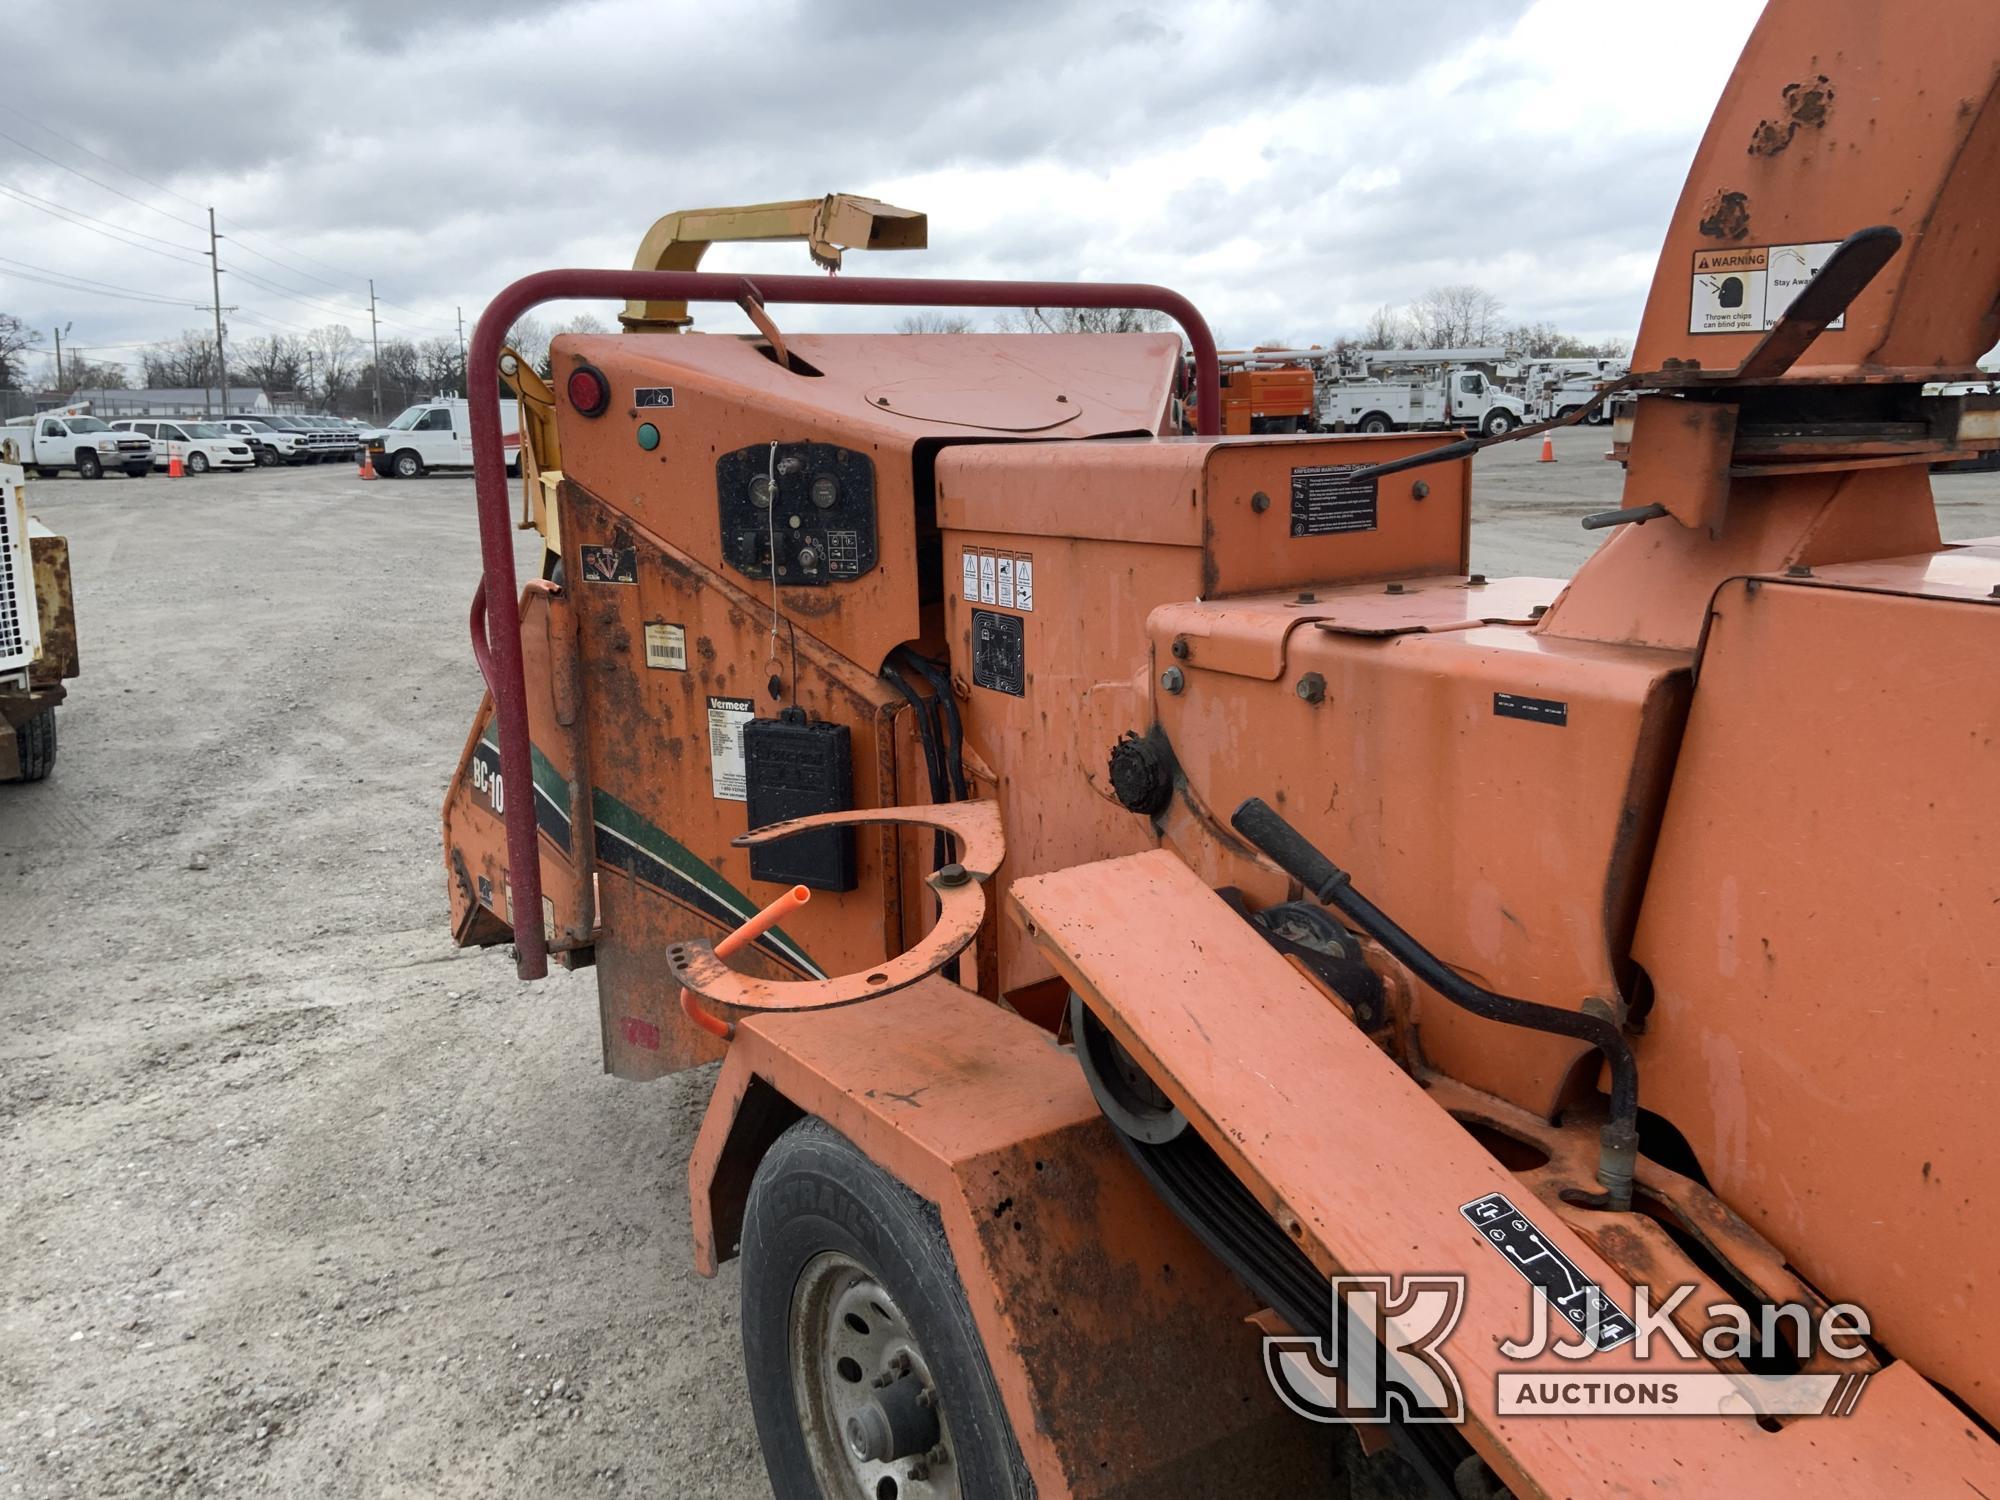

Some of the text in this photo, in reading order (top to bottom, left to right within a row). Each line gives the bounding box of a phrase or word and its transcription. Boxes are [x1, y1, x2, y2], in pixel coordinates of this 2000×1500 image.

[1712, 254, 1765, 267] WARNING
[1774, 279, 1790, 287] Stay
[1705, 312, 1752, 321] Thrown chips
[1717, 320, 1736, 328] blind
[710, 697, 749, 712] Vermeer
